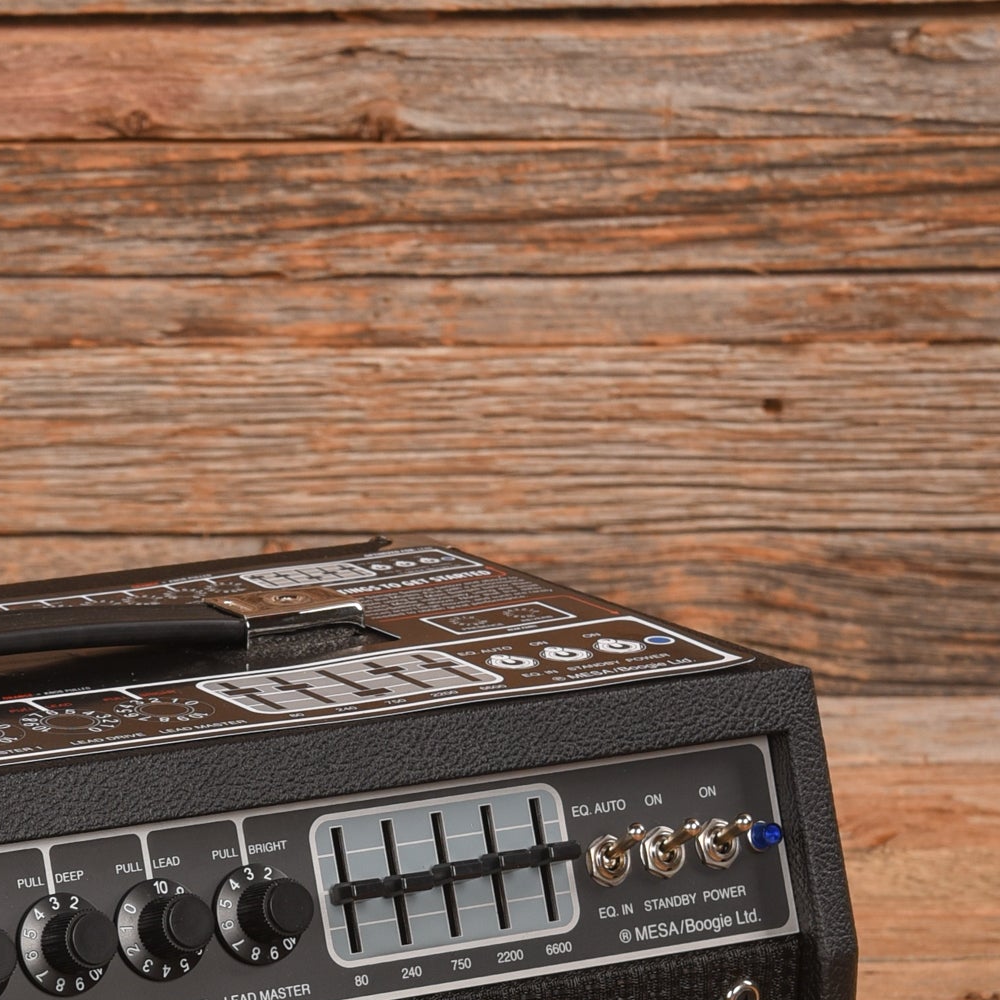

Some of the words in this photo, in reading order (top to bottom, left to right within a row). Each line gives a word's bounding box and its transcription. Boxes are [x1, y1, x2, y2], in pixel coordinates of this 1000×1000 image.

[401, 578, 430, 589] GET
[429, 569, 492, 583] STARTED
[698, 785, 716, 798] ON
[571, 804, 592, 817] EQ.
[594, 799, 626, 814] AUTO
[644, 794, 662, 806] ON
[212, 847, 239, 860] PULL
[248, 840, 287, 855] BRIGHT
[115, 861, 143, 874] PULL
[153, 856, 180, 869] LEAD
[264, 867, 273, 879] 2
[17, 876, 45, 889] PULL
[55, 870, 84, 884] DEEP
[244, 867, 254, 880] 3
[153, 880, 168, 894] 10
[229, 879, 240, 891] 4
[703, 885, 746, 903] POWER
[49, 897, 60, 910] 3
[69, 897, 79, 909] 2
[644, 893, 697, 912] STANDBY
[34, 908, 45, 921] 4
[599, 906, 619, 919] EQ.
[621, 903, 634, 916] IN
[634, 913, 733, 942] MESA/Boogie
[735, 908, 761, 924] Ltd.
[354, 974, 369, 987] 80
[401, 965, 422, 979] 240
[451, 958, 472, 971] 750
[497, 949, 524, 964] 2200
[545, 941, 572, 956] 6600
